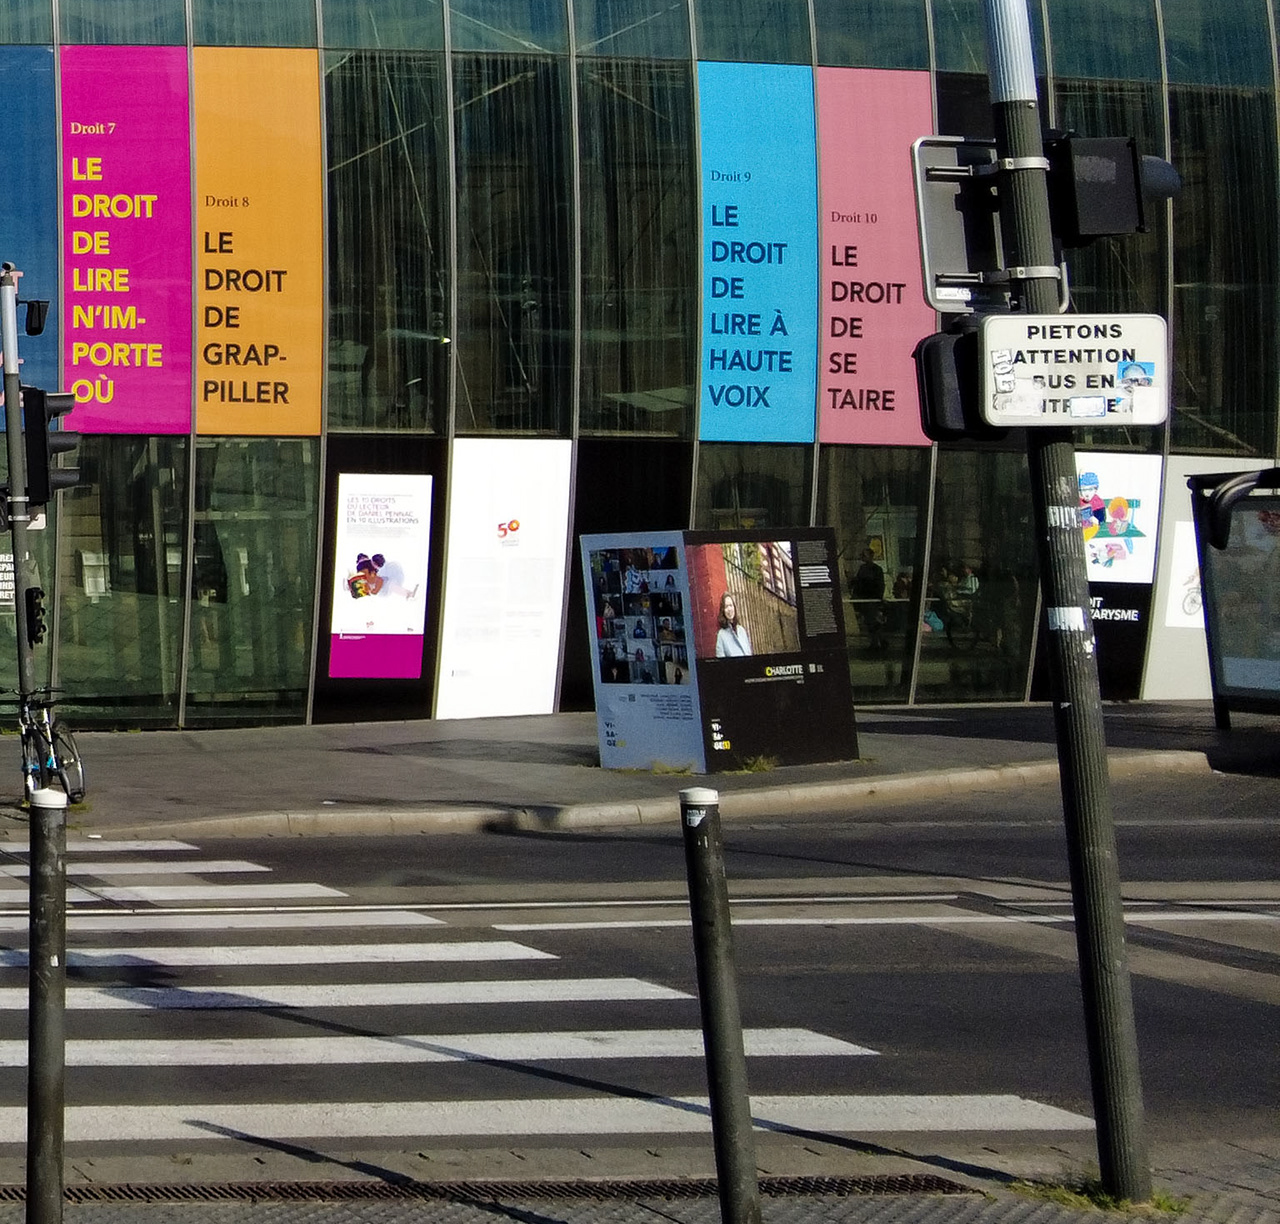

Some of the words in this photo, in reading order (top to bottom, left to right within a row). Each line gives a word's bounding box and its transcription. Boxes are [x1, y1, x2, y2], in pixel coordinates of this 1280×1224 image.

[70, 122, 104, 136] Droit
[108, 123, 116, 135] 7
[72, 157, 103, 181] LE
[711, 171, 741, 182] Droit
[744, 171, 751, 184] 9
[72, 194, 157, 218] DROIT
[205, 195, 239, 208] Droit
[242, 195, 250, 207] 8
[712, 204, 739, 227] LE
[830, 211, 860, 224] Droit
[864, 212, 878, 224] 10
[72, 231, 110, 255] DE
[204, 232, 234, 254] LE
[711, 241, 787, 265] DROIT
[831, 245, 858, 268] LE
[72, 268, 130, 292] LIRE
[204, 269, 288, 293] DROIT
[712, 277, 744, 299] DE
[831, 282, 906, 304] DROIT
[204, 306, 240, 328] DE
[711, 313, 761, 336] LIRE
[770, 307, 789, 336] À
[830, 316, 864, 339] DE
[1027, 324, 1122, 339] PIETONS
[72, 343, 163, 367] PORTE
[203, 343, 287, 366] GRAP-
[710, 349, 793, 373] HAUTE
[829, 352, 857, 375] SE
[1013, 349, 1136, 364] ATTENTION
[71, 373, 114, 404] OÙ
[203, 380, 289, 404] PILLER
[1086, 375, 1115, 388] EN
[709, 384, 771, 409] VOIX
[828, 388, 895, 411] TAIRE
[765, 665, 804, 676] CHARLOTTE
